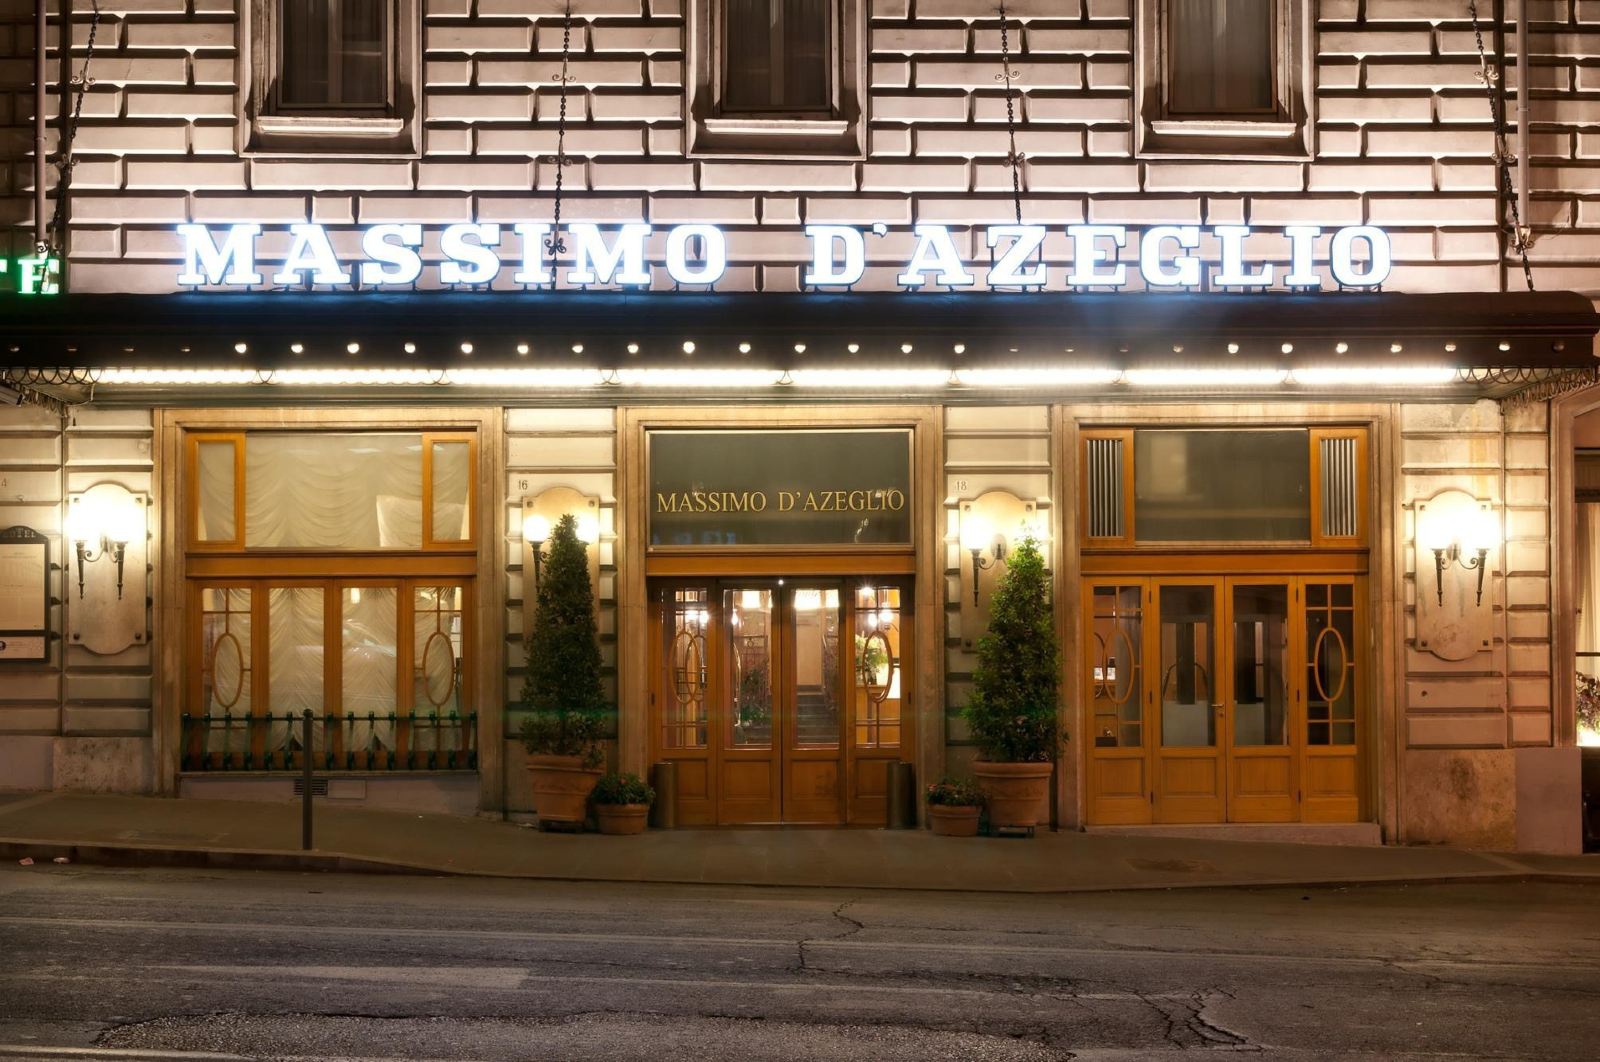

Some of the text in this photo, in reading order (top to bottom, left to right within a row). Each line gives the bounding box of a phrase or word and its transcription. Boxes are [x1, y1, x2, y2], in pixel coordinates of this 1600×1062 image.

[176, 222, 1391, 287] MASSIMO D'AZEGLIO
[518, 479, 528, 490] 16
[956, 480, 967, 491] 18
[656, 489, 905, 513] MASSIMO D'AZEGLIO
